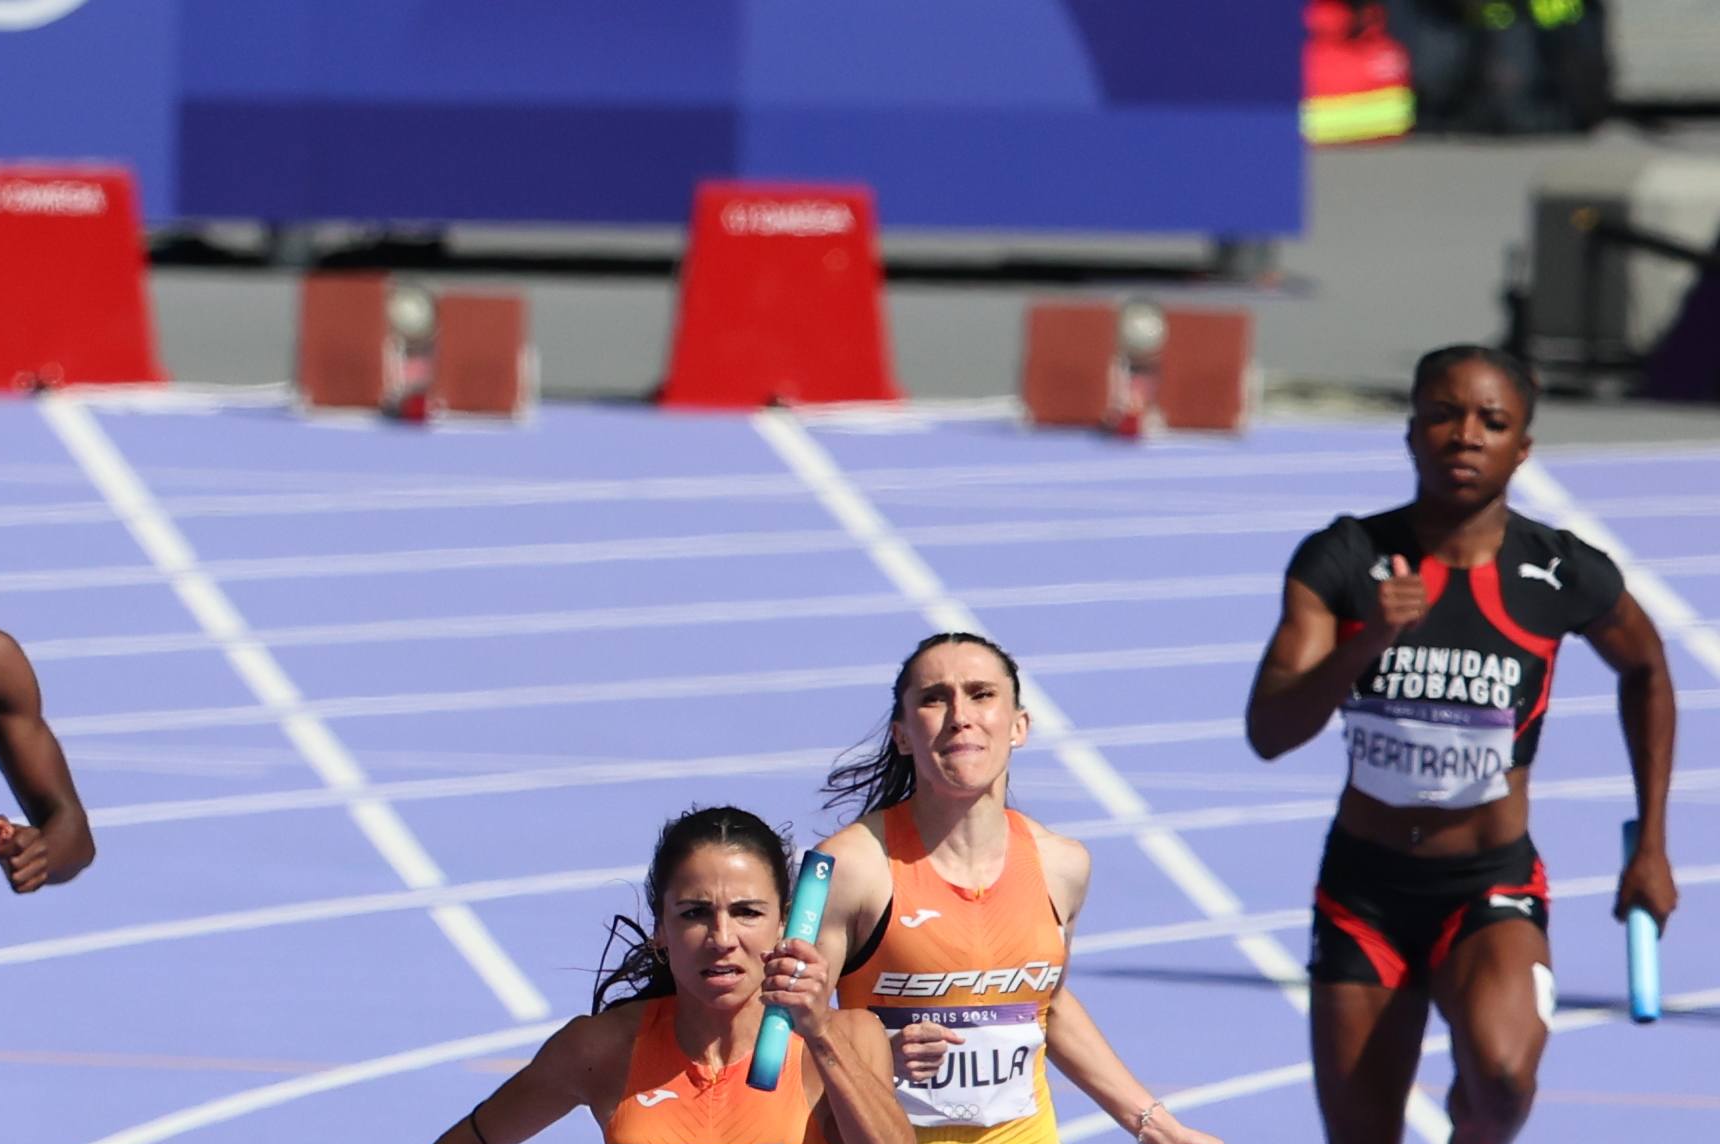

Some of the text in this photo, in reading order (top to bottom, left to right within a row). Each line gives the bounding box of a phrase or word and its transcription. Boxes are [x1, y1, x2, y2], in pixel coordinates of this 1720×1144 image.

[1380, 646, 1522, 687] TRINIDAD
[1352, 726, 1502, 779] BERTRAND
[815, 861, 829, 880] 3
[872, 960, 1064, 997] ESPAÑA
[962, 1010, 998, 1022] 2024
